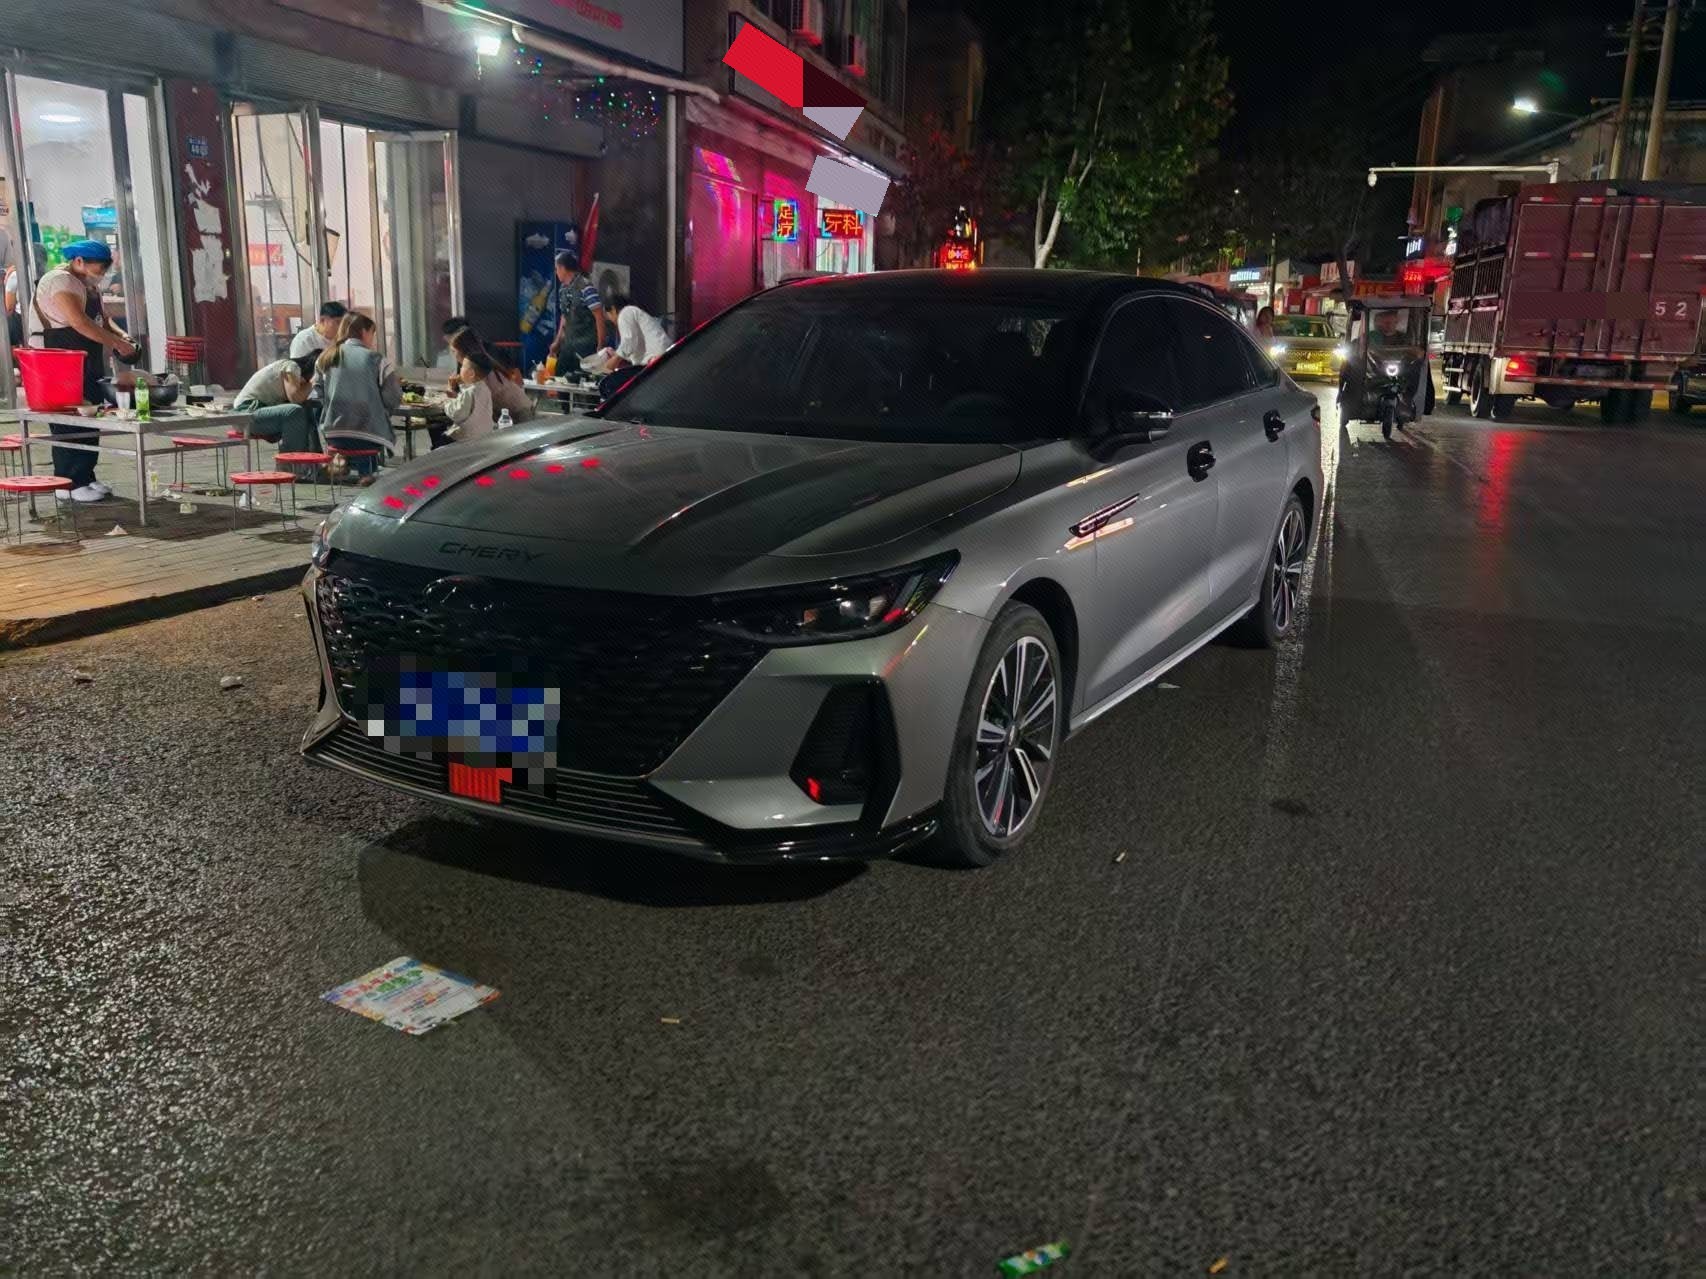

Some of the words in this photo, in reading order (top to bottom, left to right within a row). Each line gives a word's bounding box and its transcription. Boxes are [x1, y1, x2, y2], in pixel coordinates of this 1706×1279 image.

[778, 204, 794, 237] 足疗
[825, 212, 862, 235] 牙科
[439, 541, 545, 564] CHERY
